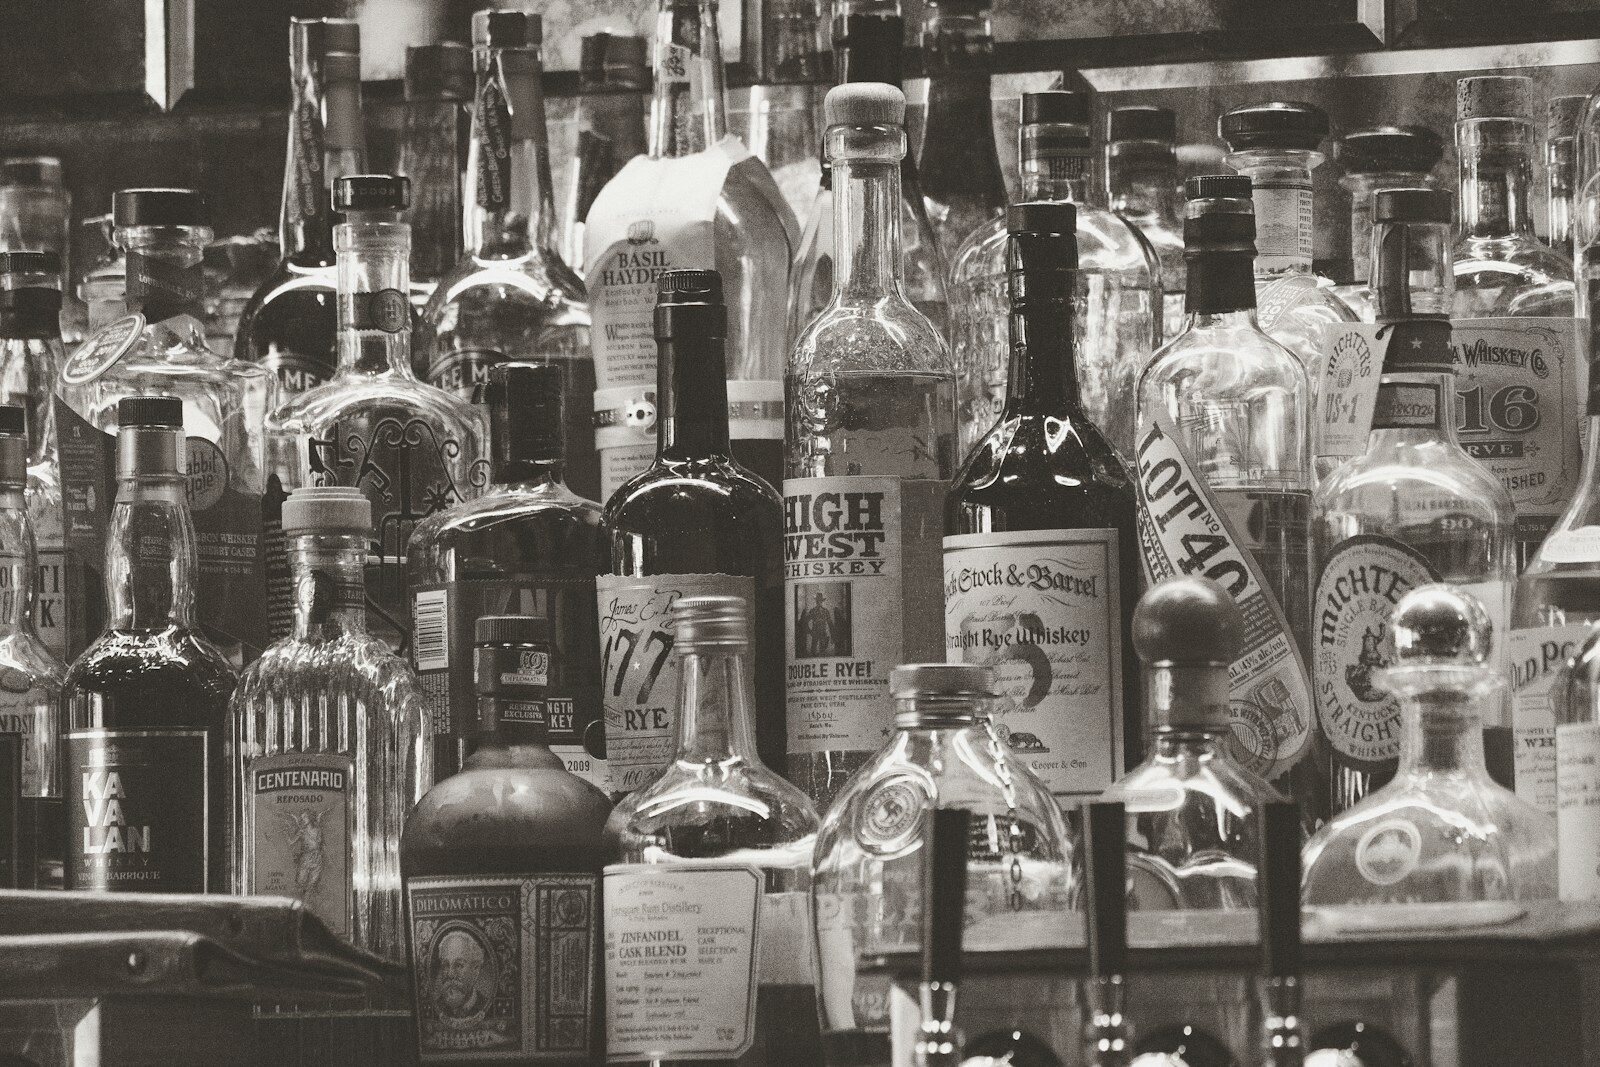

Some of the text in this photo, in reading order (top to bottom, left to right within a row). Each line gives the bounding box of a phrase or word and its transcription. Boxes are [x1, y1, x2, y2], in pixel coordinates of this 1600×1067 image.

[617, 249, 671, 269] BASIL
[602, 268, 664, 287] HAYDE
[1326, 331, 1371, 378] MICHTER'S
[1462, 338, 1528, 368] WHISKEY
[285, 370, 317, 391] ME
[1456, 384, 1540, 435] 16
[1466, 443, 1515, 456] RVE
[186, 449, 218, 476] abbit
[1502, 472, 1546, 491] ISHED
[784, 492, 885, 534] HIGH
[1139, 420, 1208, 534] LOT
[1176, 533, 1250, 598] 40
[221, 533, 258, 545] WHISKEY
[784, 532, 886, 561] WEST
[1142, 506, 1174, 579] CANADIAN
[1141, 526, 1166, 584] WHIS
[959, 562, 1004, 593] Stock
[1006, 563, 1026, 587] &
[1026, 564, 1099, 598] Barrel
[601, 597, 639, 635] James
[1320, 564, 1416, 648] MICHTE
[1369, 599, 1393, 620] BA
[982, 626, 1013, 651] Rye
[1016, 626, 1090, 647] Whiskey
[602, 627, 675, 706] 177
[788, 660, 872, 680] DOUBLE RYE!
[508, 703, 540, 713] RESERVA
[547, 702, 574, 715] NGTH
[624, 707, 670, 731] RYE
[1322, 682, 1401, 741] STRAIGHT
[549, 715, 574, 728] KEY
[568, 760, 590, 772] 2009
[1060, 760, 1068, 770] &
[82, 771, 127, 800] KA
[258, 770, 343, 791] CENTENARIO
[276, 794, 324, 804] REPOSADO
[82, 799, 126, 827] VA
[83, 825, 151, 854] LAN
[106, 871, 161, 881] BARRIQUE
[661, 901, 702, 915] Distillery
[621, 929, 684, 944] ZINFANDEL
[619, 946, 643, 959] CASK
[644, 944, 688, 958] BLEND
